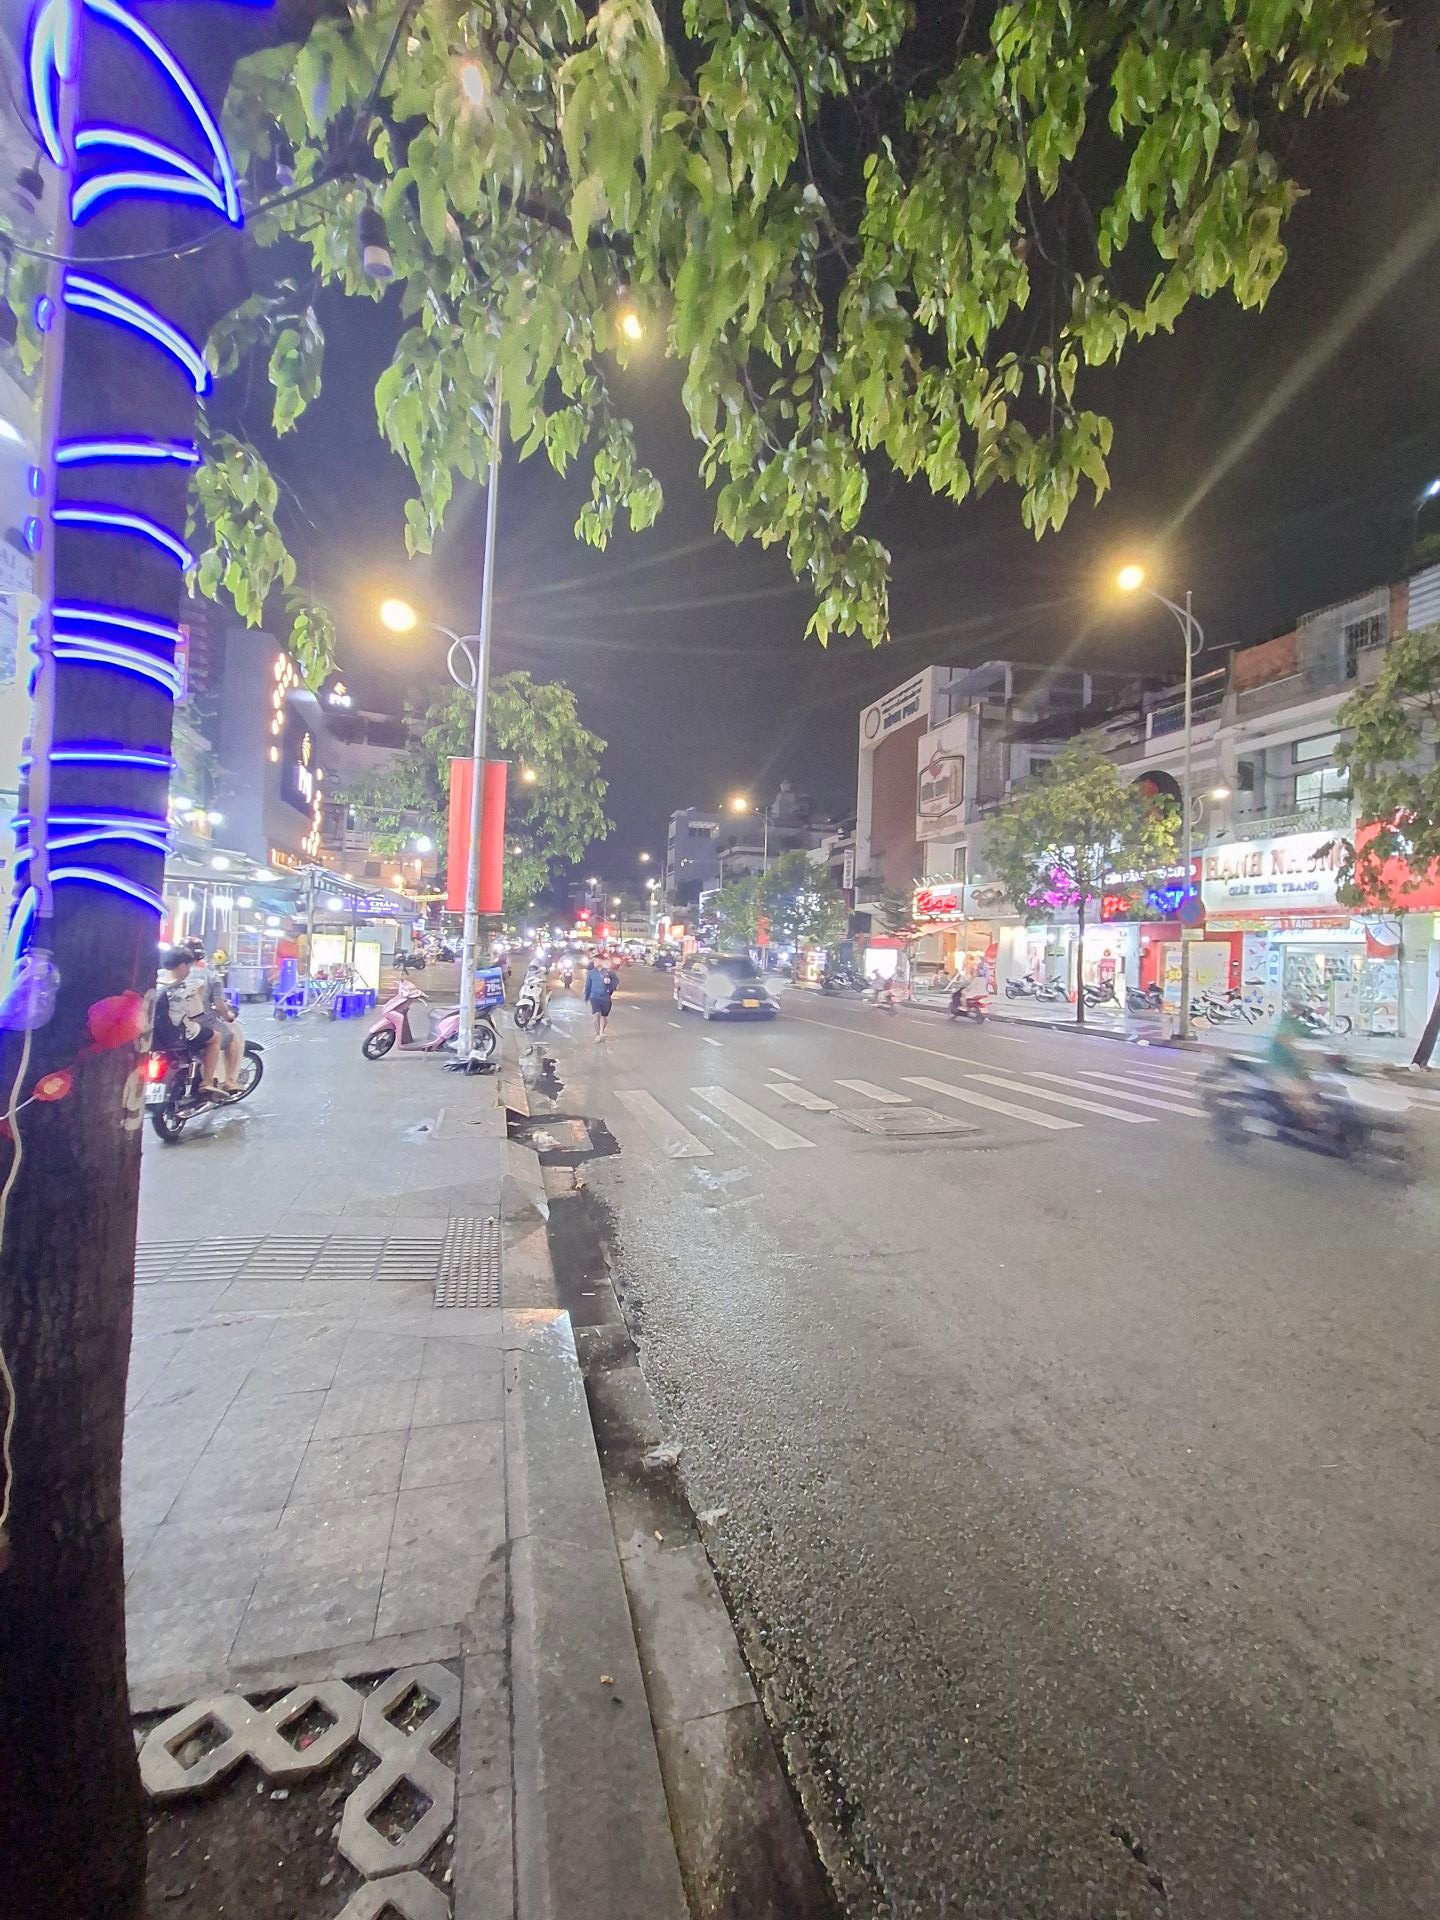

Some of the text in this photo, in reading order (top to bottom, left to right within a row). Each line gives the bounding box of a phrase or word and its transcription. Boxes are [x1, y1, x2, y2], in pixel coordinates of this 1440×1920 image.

[1205, 849, 1263, 883] HẠNH
[1281, 880, 1319, 894] TRANG
[485, 983, 502, 993] 70%
